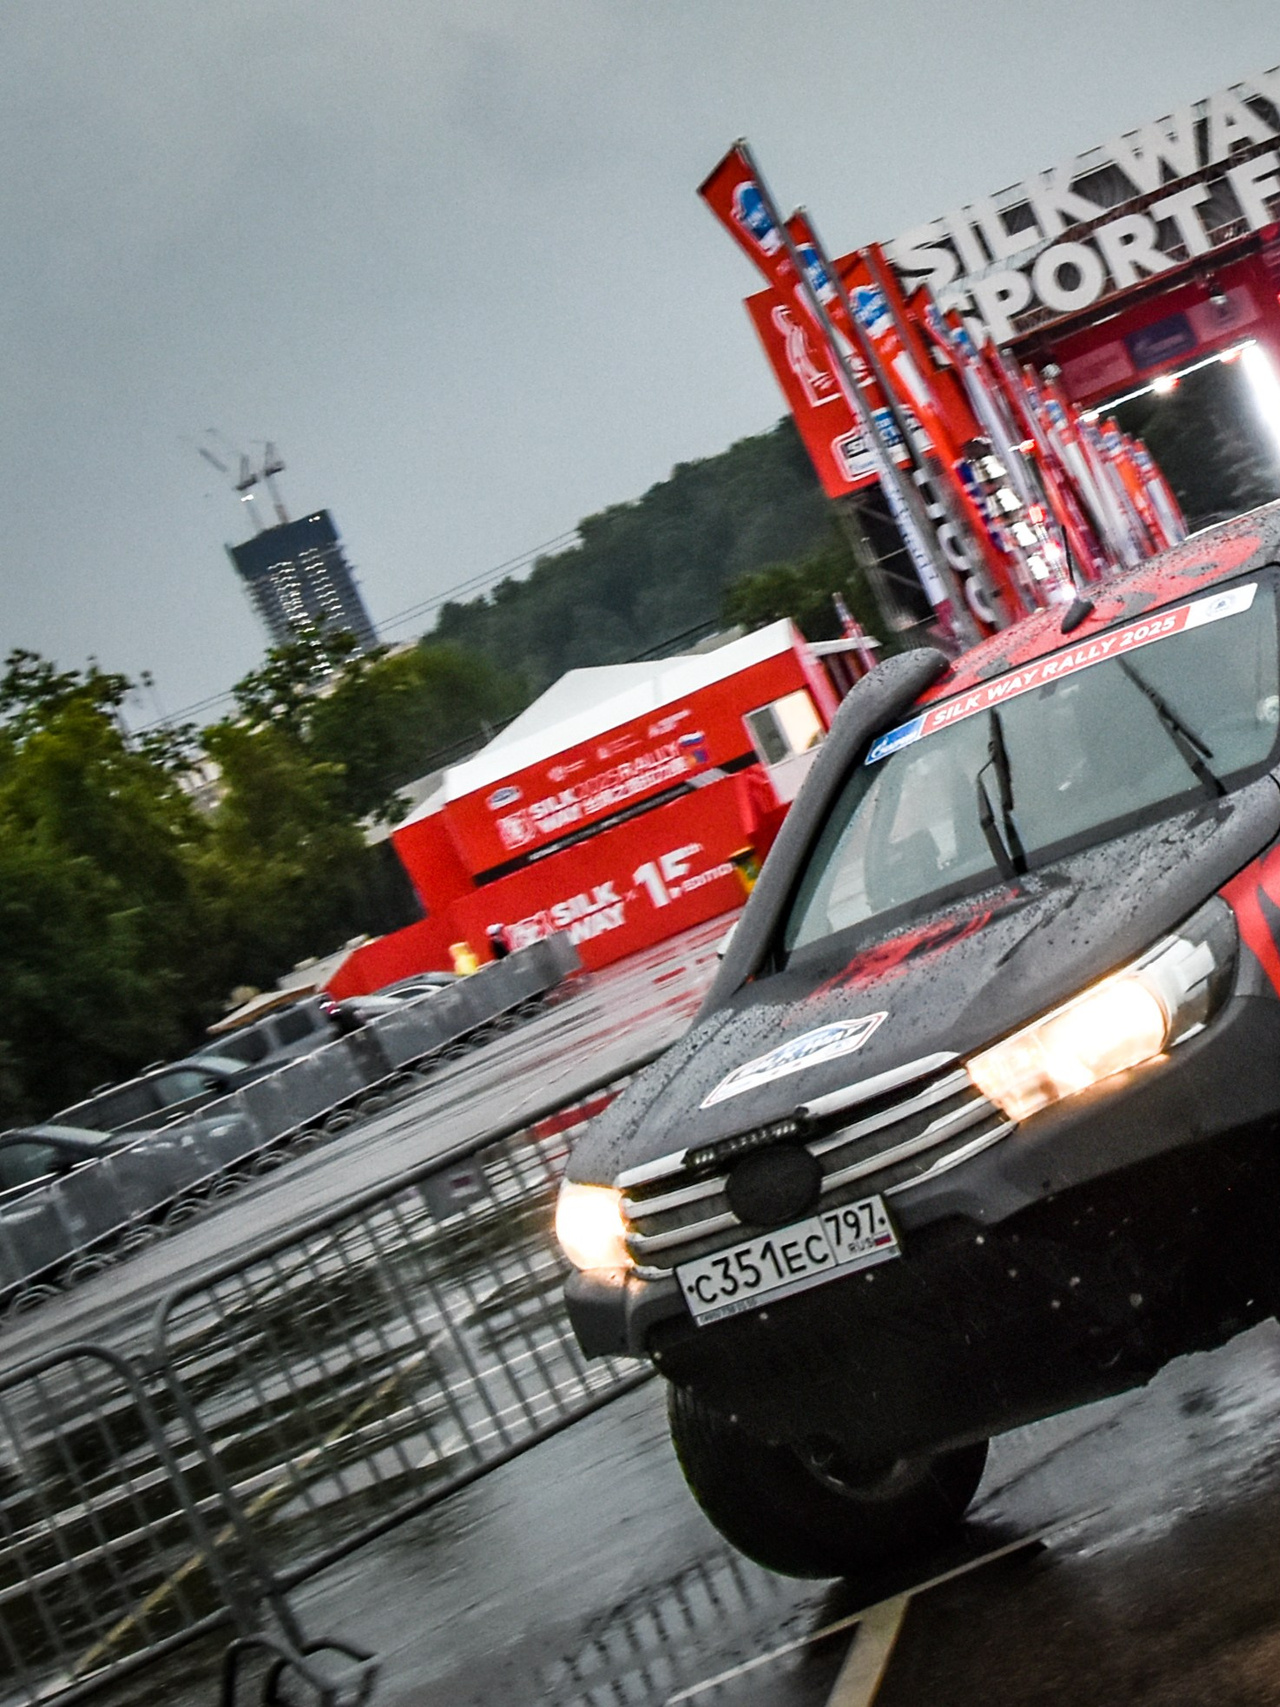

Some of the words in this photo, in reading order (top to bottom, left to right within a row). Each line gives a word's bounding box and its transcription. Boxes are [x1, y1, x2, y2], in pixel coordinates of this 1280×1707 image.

[888, 155, 1108, 297] SILK
[935, 183, 1213, 364] SPORT
[933, 693, 981, 726] SILK
[986, 671, 1040, 702] WAY
[1041, 637, 1118, 678] RALLY
[1121, 615, 1177, 645] 2025
[551, 880, 623, 926] SILK
[568, 902, 626, 946] WAY
[824, 1203, 876, 1246] 797
[847, 1238, 876, 1254] RUS
